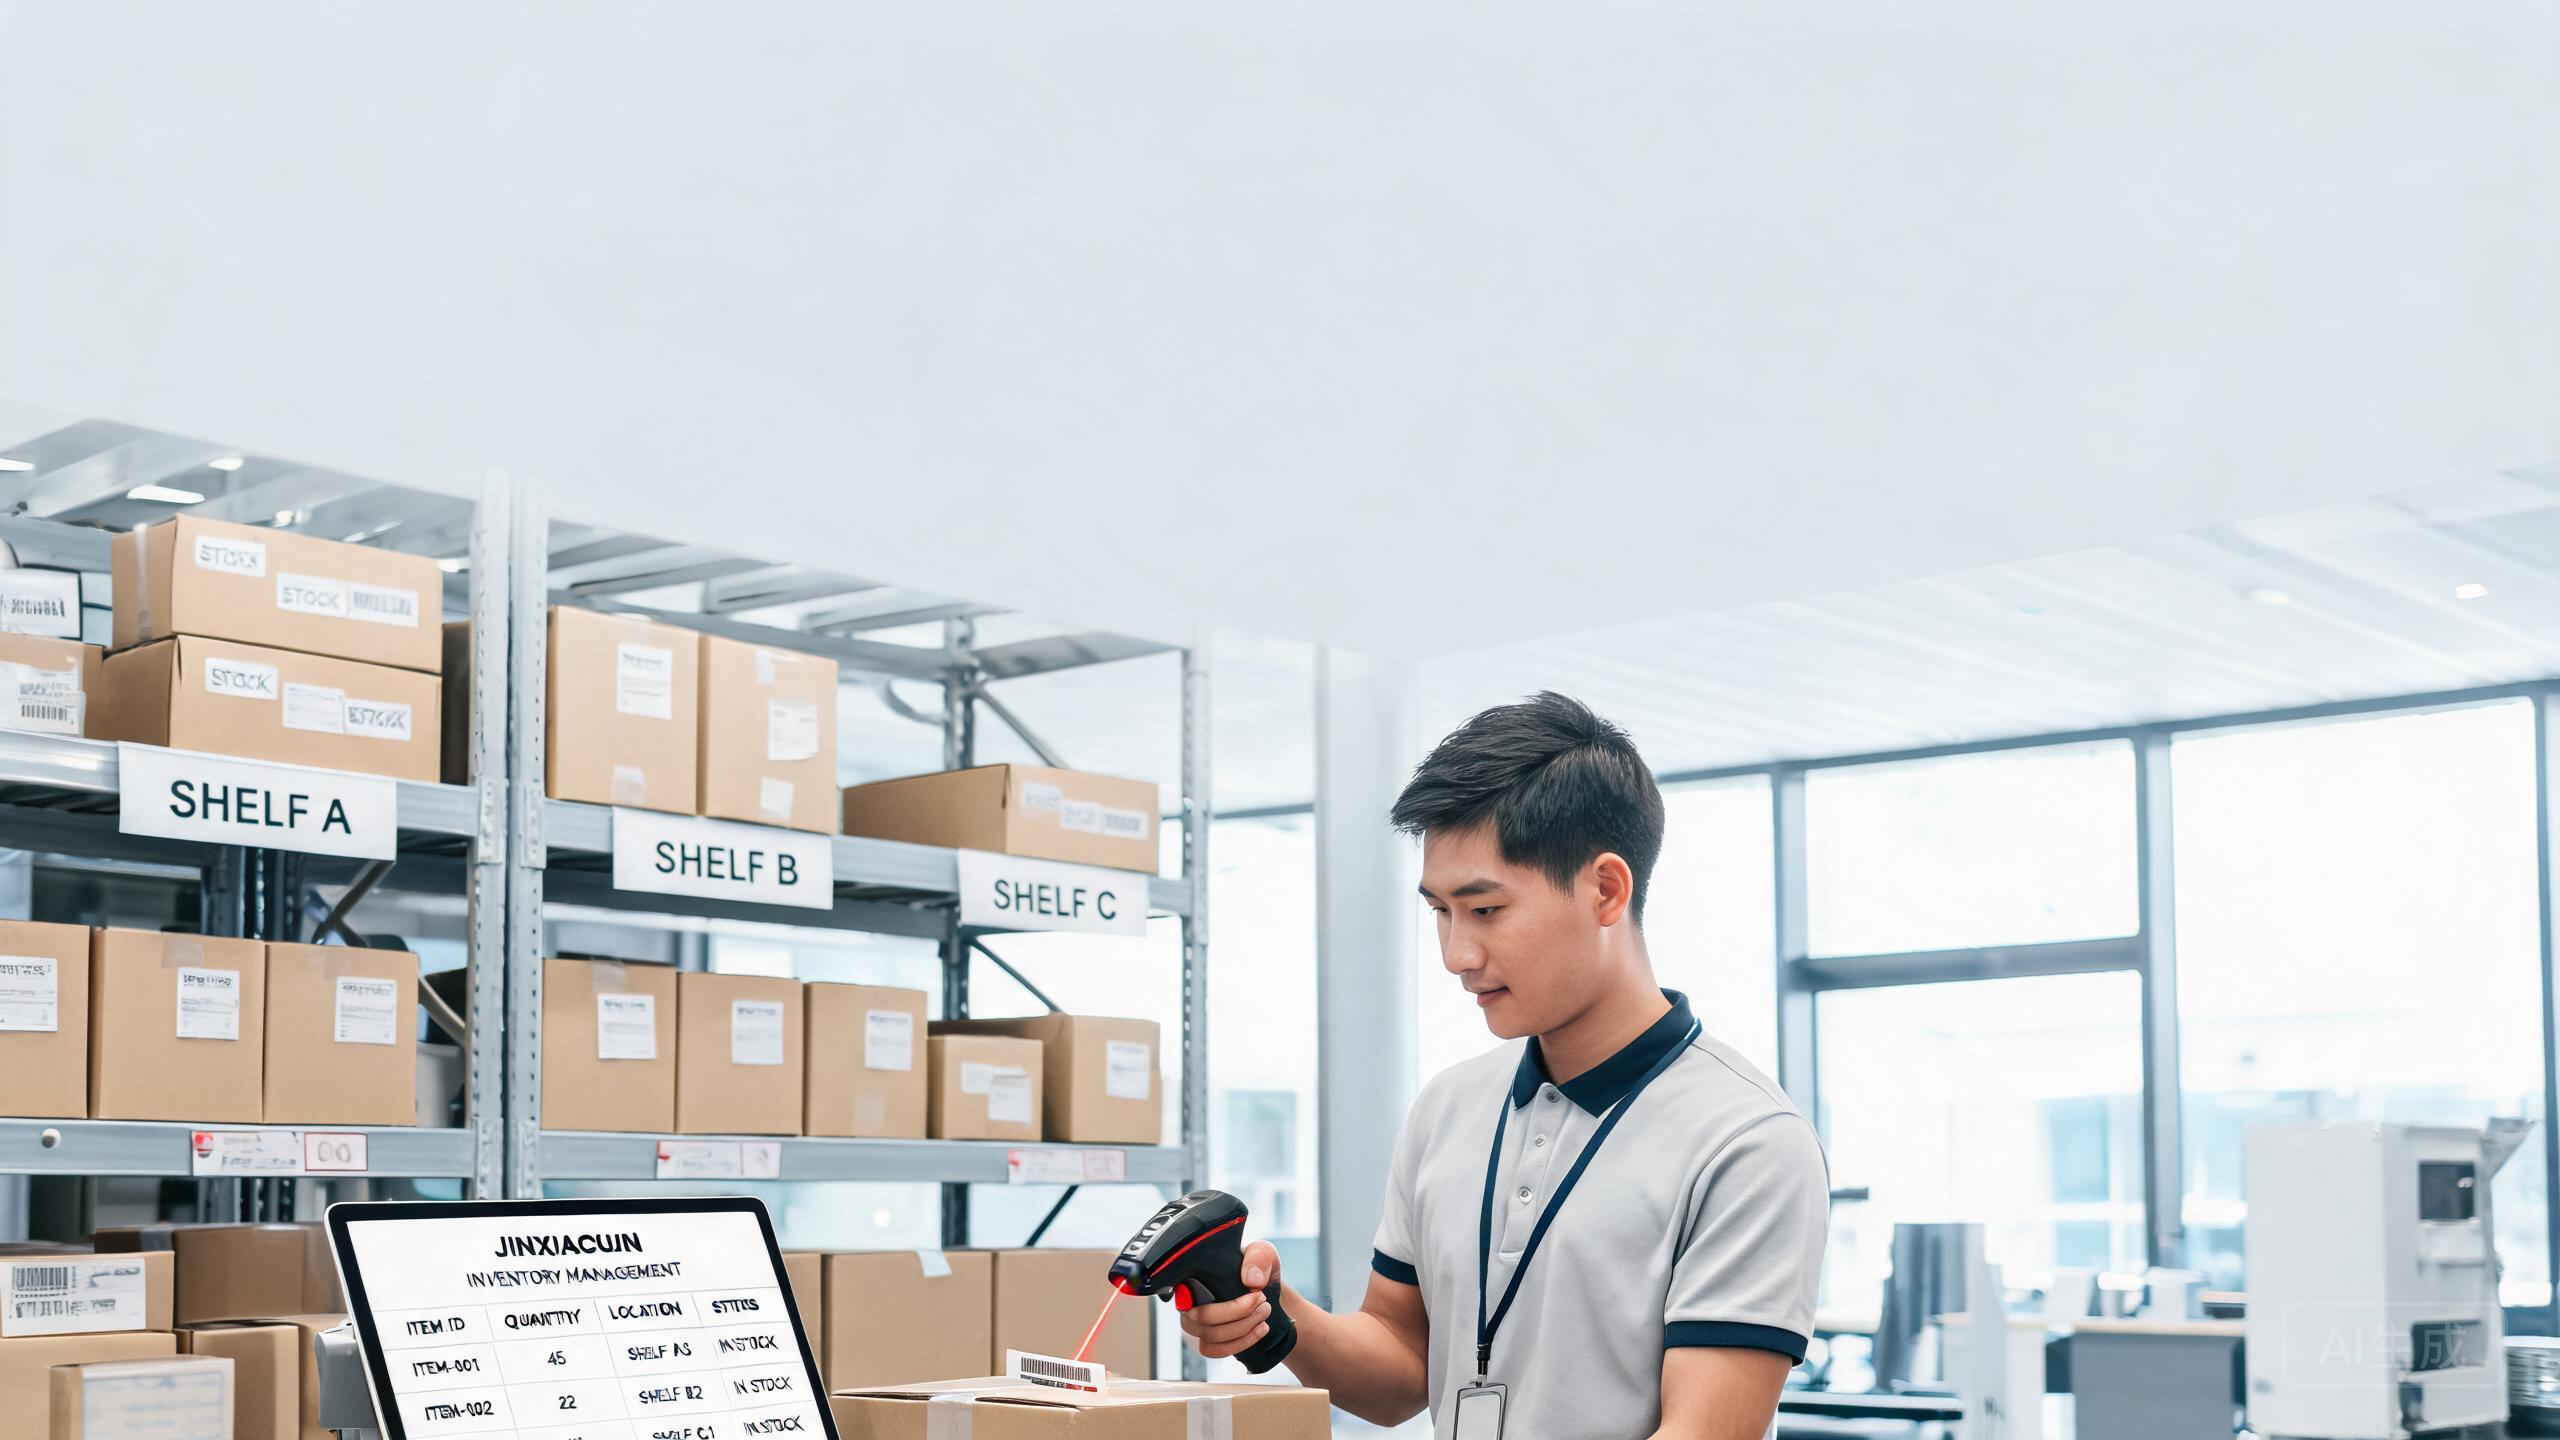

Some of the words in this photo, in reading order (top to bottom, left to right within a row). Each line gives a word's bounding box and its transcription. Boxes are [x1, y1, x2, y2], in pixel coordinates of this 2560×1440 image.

[169, 779, 309, 829] SHELF
[321, 798, 352, 835] A
[655, 841, 764, 883] SHELF
[778, 853, 798, 886] B
[994, 879, 1086, 918] SHELF
[1097, 891, 1116, 920] C
[466, 1269, 561, 1288] INVENTORY
[565, 1261, 681, 1284] MANAGEMENT
[608, 1301, 683, 1320] LOCATION
[447, 1317, 466, 1332] ID
[412, 1358, 481, 1377] ITEM-001
[547, 1350, 567, 1366] 45
[424, 1400, 495, 1421] ITEM-002
[558, 1394, 578, 1410] 22
